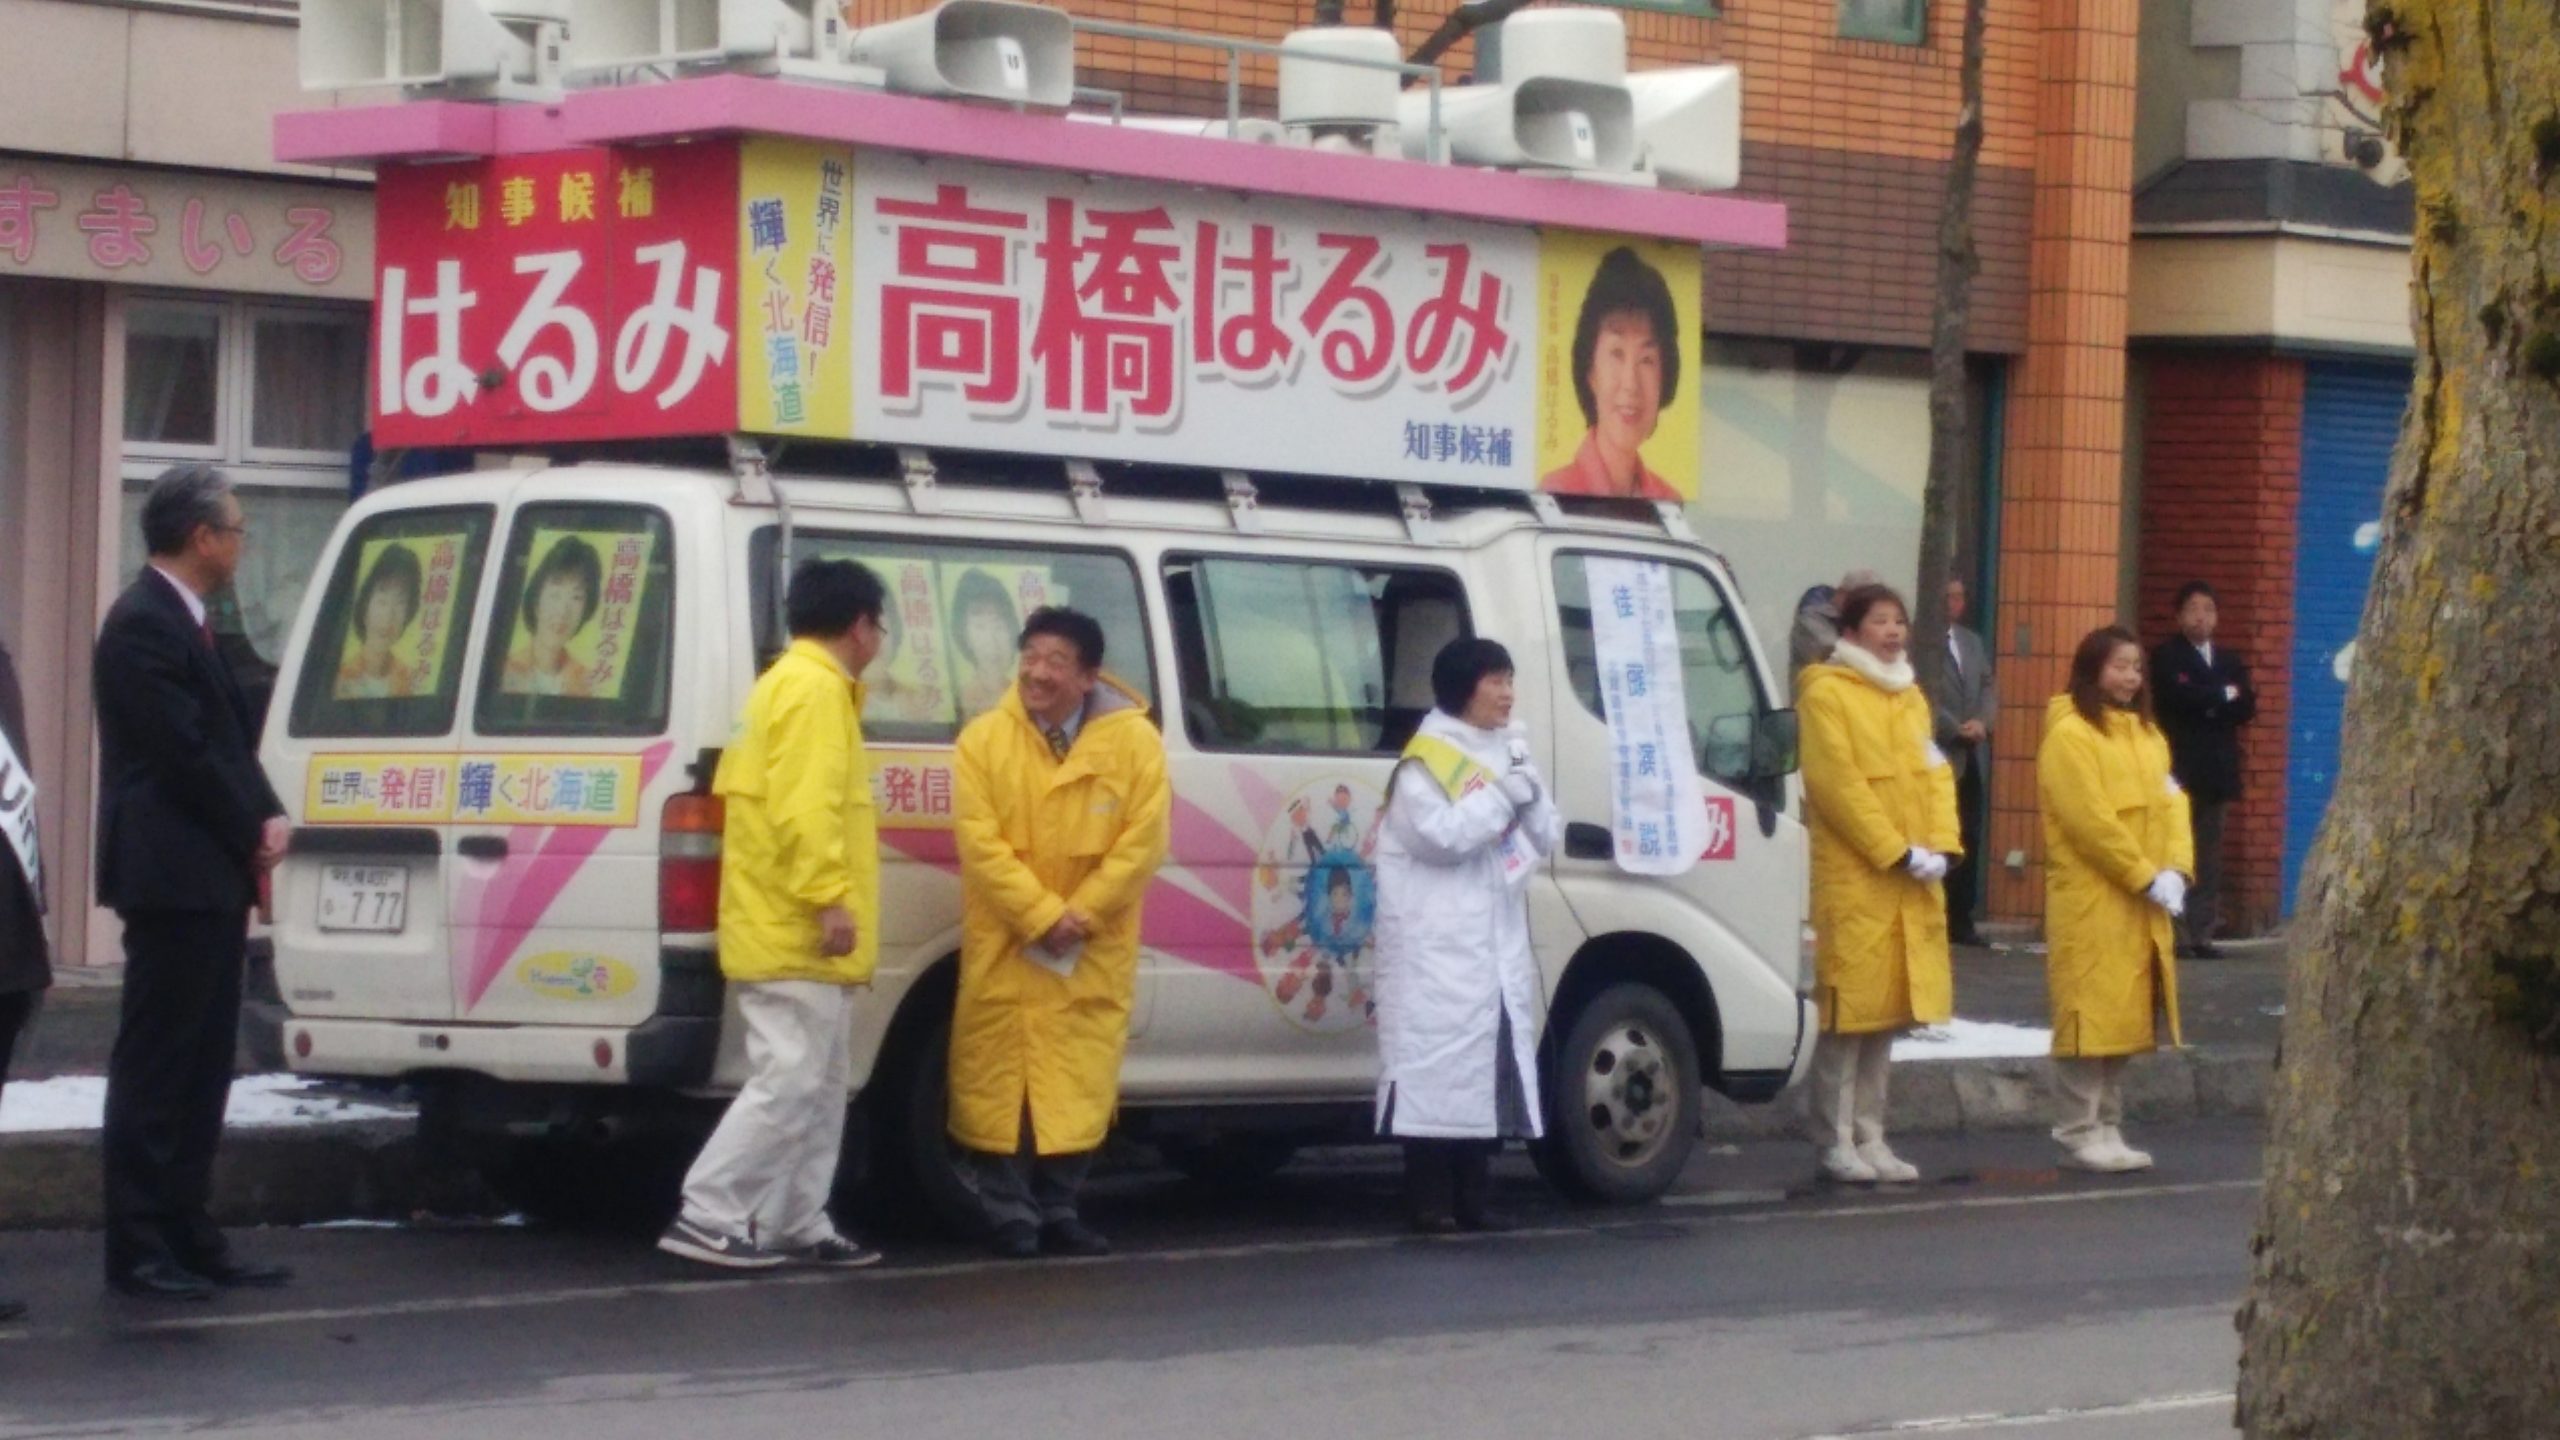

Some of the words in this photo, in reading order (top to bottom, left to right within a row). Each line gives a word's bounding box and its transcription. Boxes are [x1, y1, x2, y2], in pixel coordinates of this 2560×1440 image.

[444, 167, 656, 231] 知事候補
[379, 238, 731, 418] はるみ
[749, 197, 805, 425] 輝く北海道
[874, 183, 1510, 420] 高橋はるみ
[1403, 419, 1513, 468] 知事候補
[590, 536, 645, 684] 高橋はるみ
[458, 760, 620, 813] 輝く北海道
